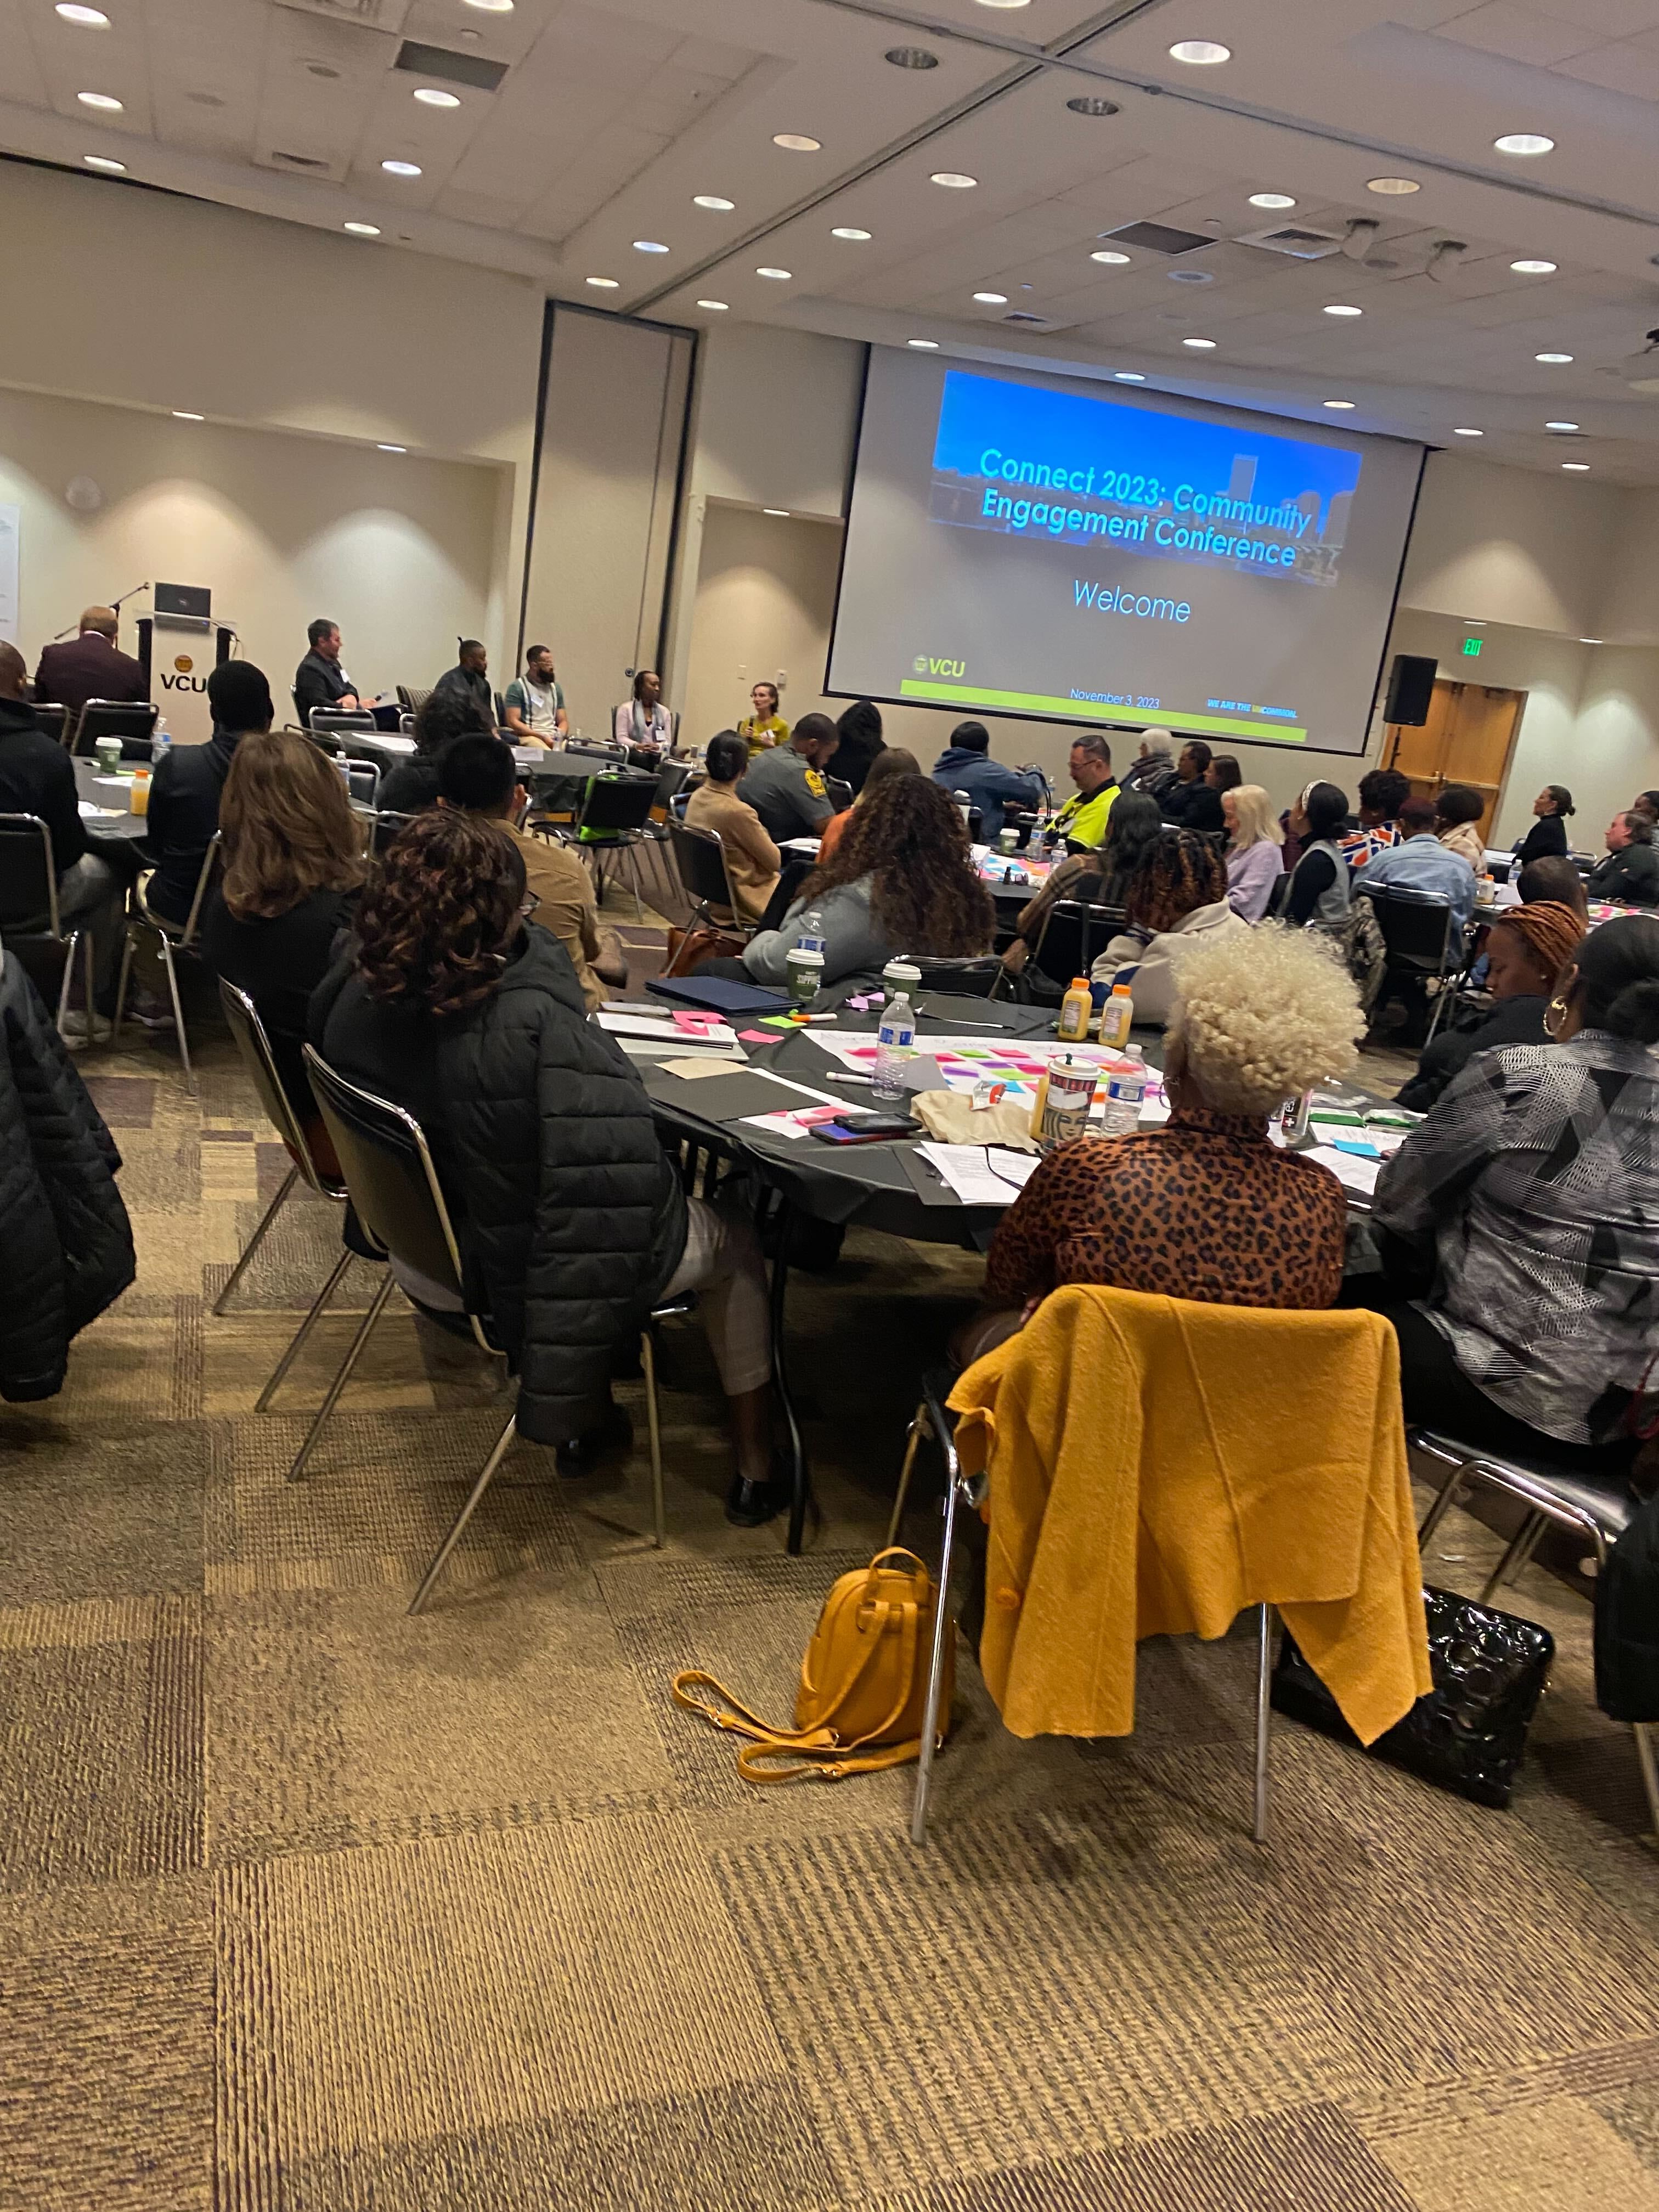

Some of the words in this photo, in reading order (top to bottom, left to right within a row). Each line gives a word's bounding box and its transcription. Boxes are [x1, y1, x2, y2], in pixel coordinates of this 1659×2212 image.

[980, 448, 1095, 493] Connect
[1099, 470, 1166, 506] 2023:
[1174, 484, 1312, 538] Community
[983, 488, 1149, 541] Engagement
[1155, 518, 1296, 567] Conference
[1075, 579, 1190, 623] Welcome
[1463, 639, 1483, 656] EXIT
[929, 658, 966, 677] VCU
[160, 673, 207, 693] VCU
[1070, 687, 1124, 704] November
[1125, 695, 1133, 707] 3,
[1137, 696, 1160, 709] 2023
[1207, 698, 1220, 708] WE
[1220, 701, 1236, 710] ARE
[1237, 702, 1251, 712] THE
